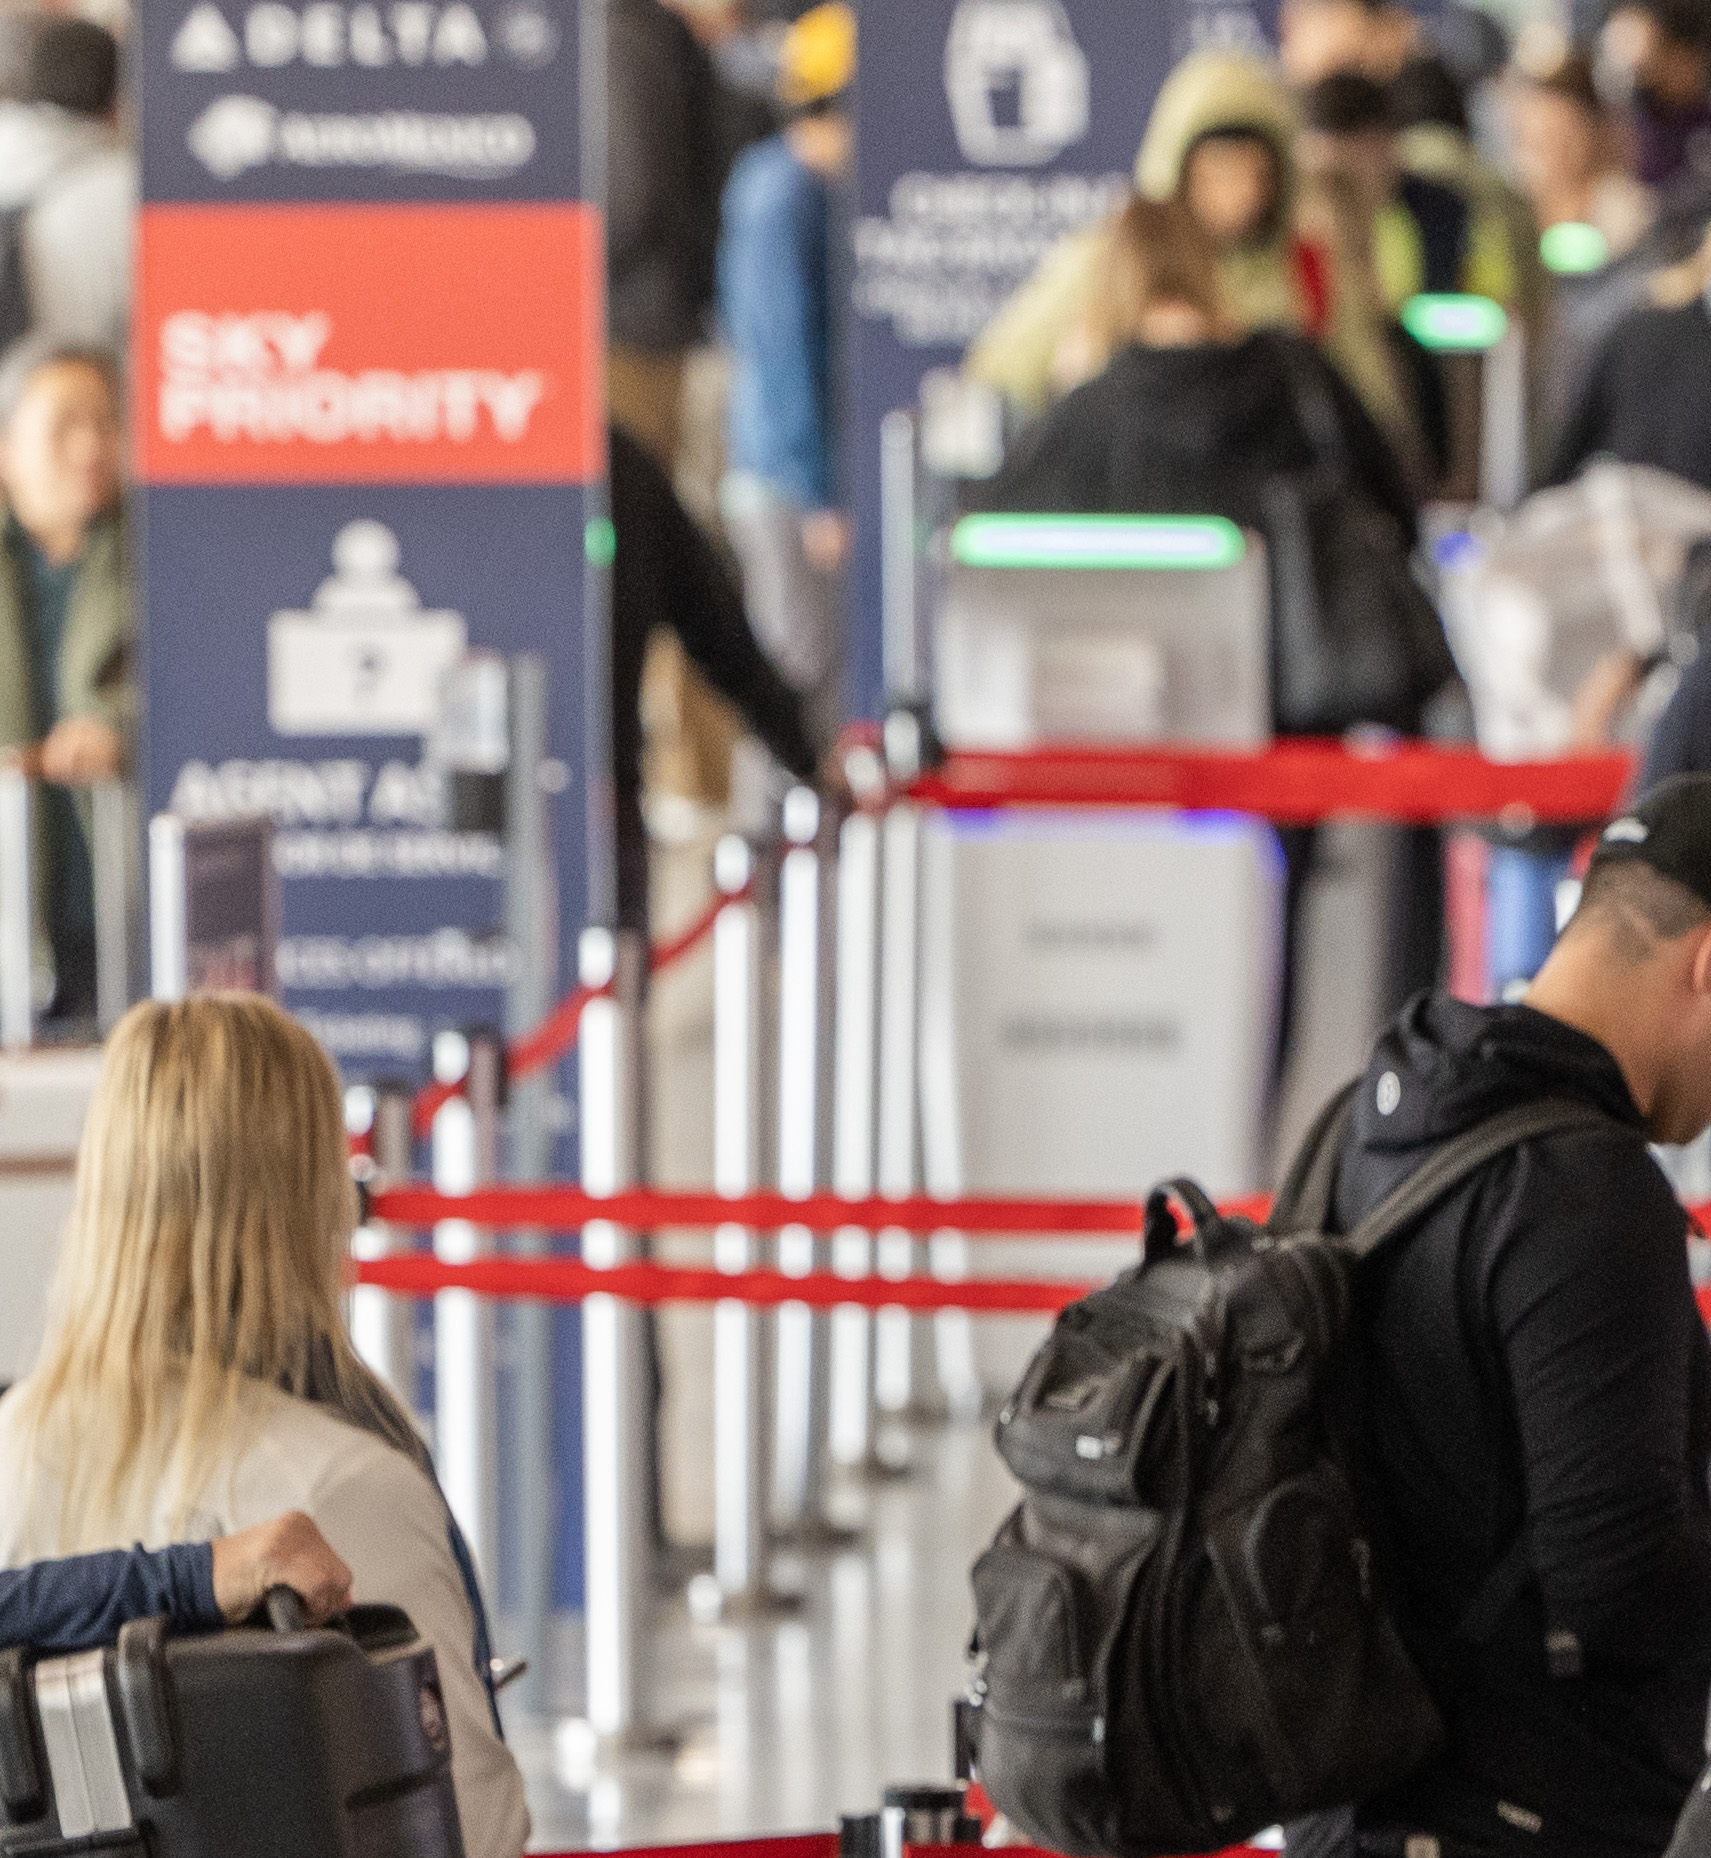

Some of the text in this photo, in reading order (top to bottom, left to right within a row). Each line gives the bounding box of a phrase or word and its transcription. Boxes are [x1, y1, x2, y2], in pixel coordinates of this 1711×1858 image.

[245, 3, 489, 69] DELTA
[160, 309, 331, 372] SKY
[160, 371, 545, 443] PRIORITY
